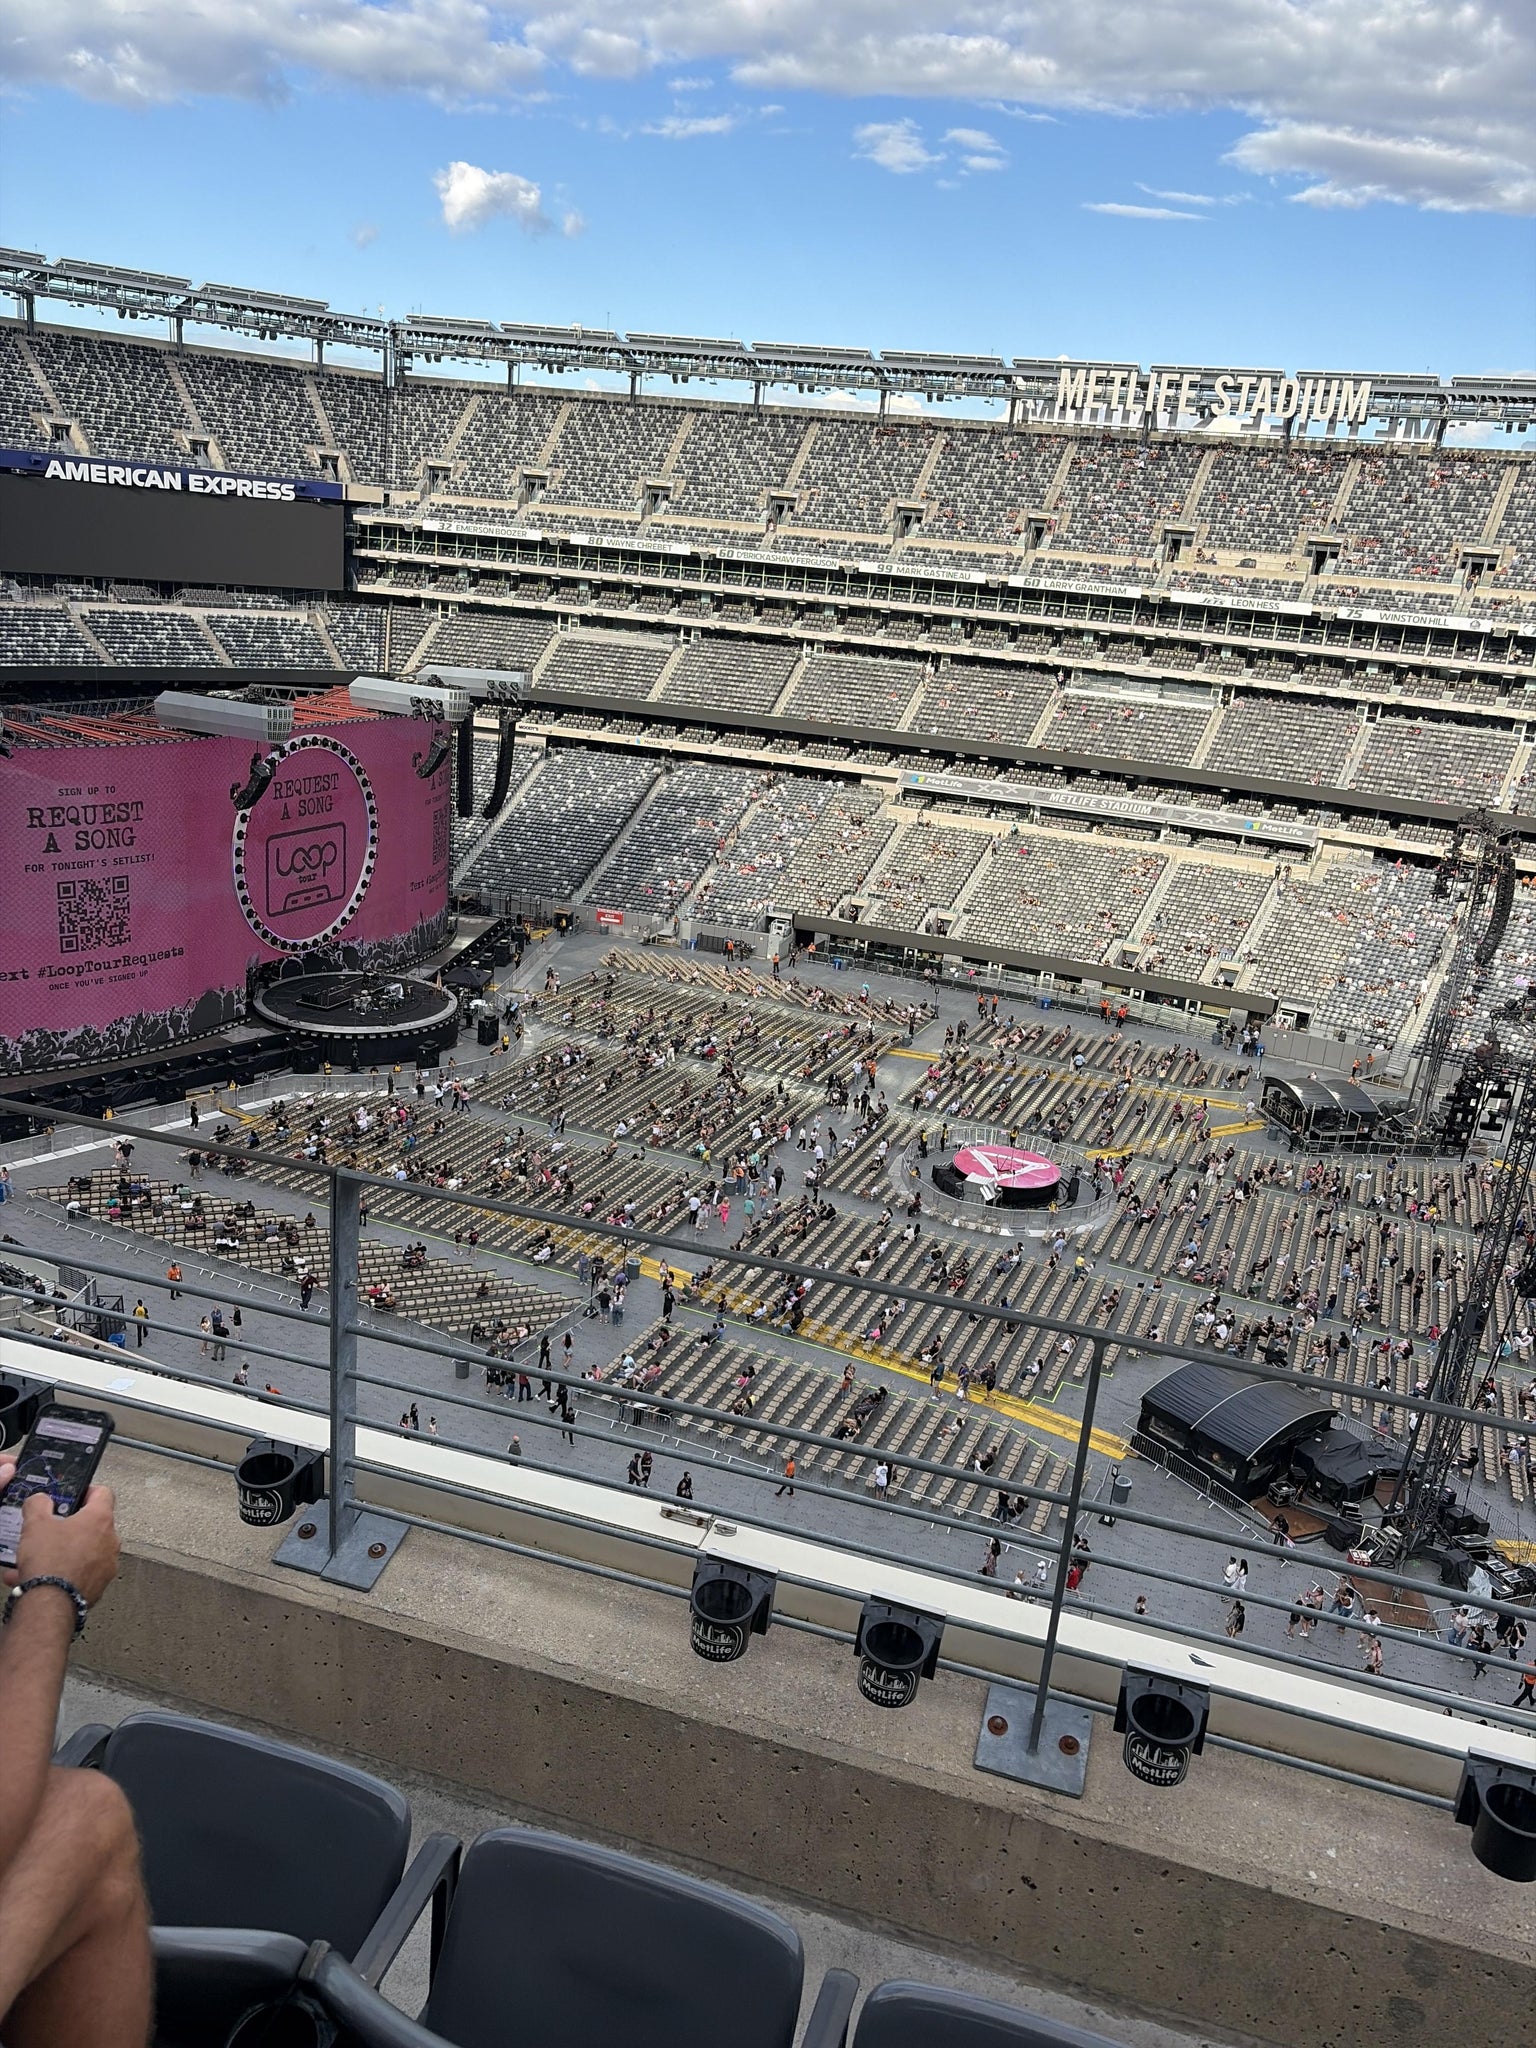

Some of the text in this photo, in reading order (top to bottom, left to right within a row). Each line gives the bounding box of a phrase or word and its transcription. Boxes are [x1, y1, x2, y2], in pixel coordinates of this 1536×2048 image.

[1057, 368, 1202, 415] METLIFE
[1211, 374, 1372, 423] STADIUM
[44, 459, 296, 502] AMERICAN EXPRESS
[437, 521, 528, 539] 32 EMERSON BOOZER
[587, 536, 673, 553] 80 WAYNE CHREBET
[718, 548, 735, 559] 60
[796, 556, 838, 568] FERGUSON
[876, 563, 971, 581] 99 MARK GASTINEAU
[1022, 577, 1128, 596] 60 LARRY GRANTHAM
[1231, 598, 1255, 609] LEON
[1256, 600, 1280, 611] HESS
[1345, 607, 1449, 627] 75 WINSTON HILL
[58, 785, 116, 797] SIGN UP TO
[273, 772, 340, 801] REQUEST
[925, 776, 963, 789] MetLife
[26, 800, 144, 829] REQUEST
[280, 794, 334, 821] A SONG
[1048, 792, 1152, 816] METLIFE STADIUM
[42, 826, 137, 854] A SONG
[1261, 823, 1304, 837] MetLife
[24, 853, 156, 874] FOR TONIGHT'S SETLIST!
[37, 946, 185, 979] #LoopTourRequests
[49, 969, 149, 992] ONCE YOU'VE SIGNED UP
[692, 1634, 732, 1654] MetLife
[862, 1678, 904, 1700] MetLife
[1131, 1756, 1179, 1779] MetLife
